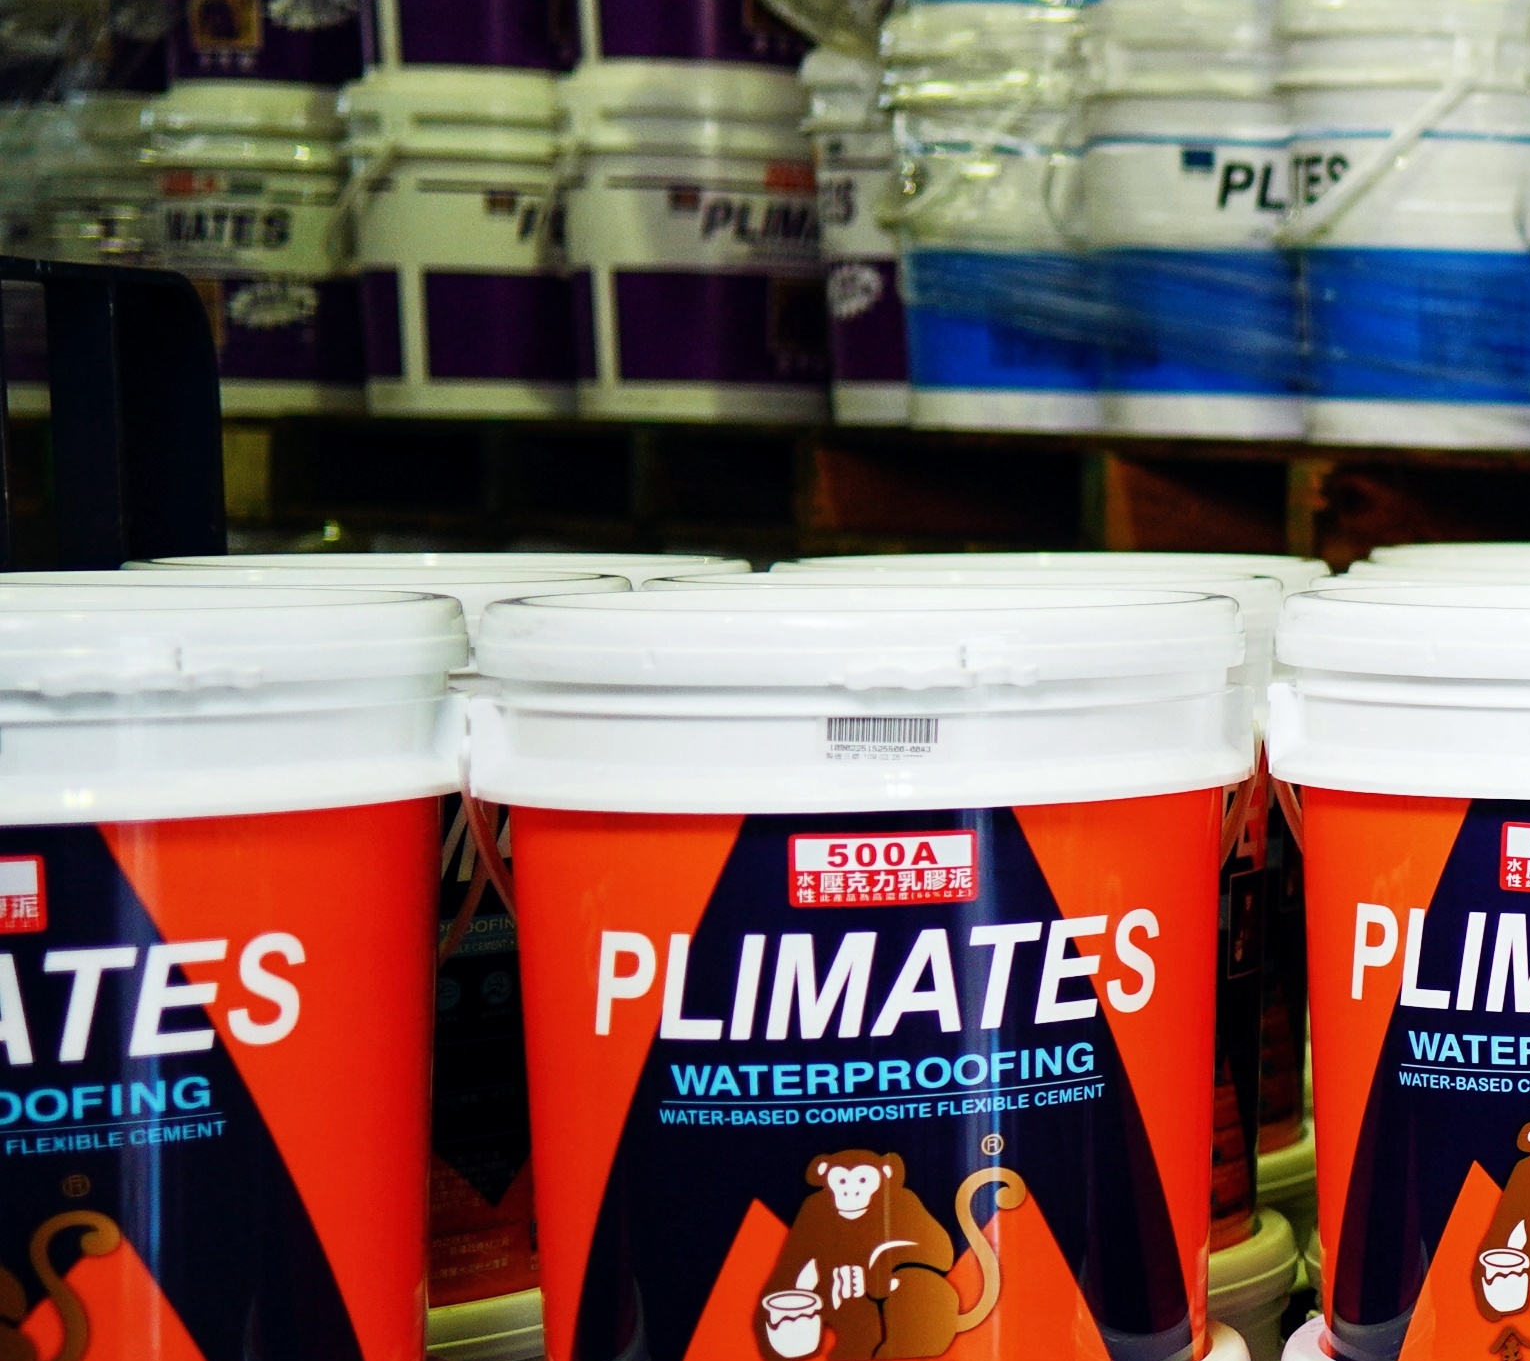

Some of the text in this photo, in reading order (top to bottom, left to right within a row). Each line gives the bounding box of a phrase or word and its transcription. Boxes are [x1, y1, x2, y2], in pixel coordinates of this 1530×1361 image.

[827, 841, 938, 868] 500A
[594, 908, 1160, 1040] PLIMATES
[670, 1042, 1095, 1097] WATERPROOFING
[1399, 1070, 1513, 1093] WATER-BASED
[5, 1120, 227, 1155] FLEXIBLE CEMENT
